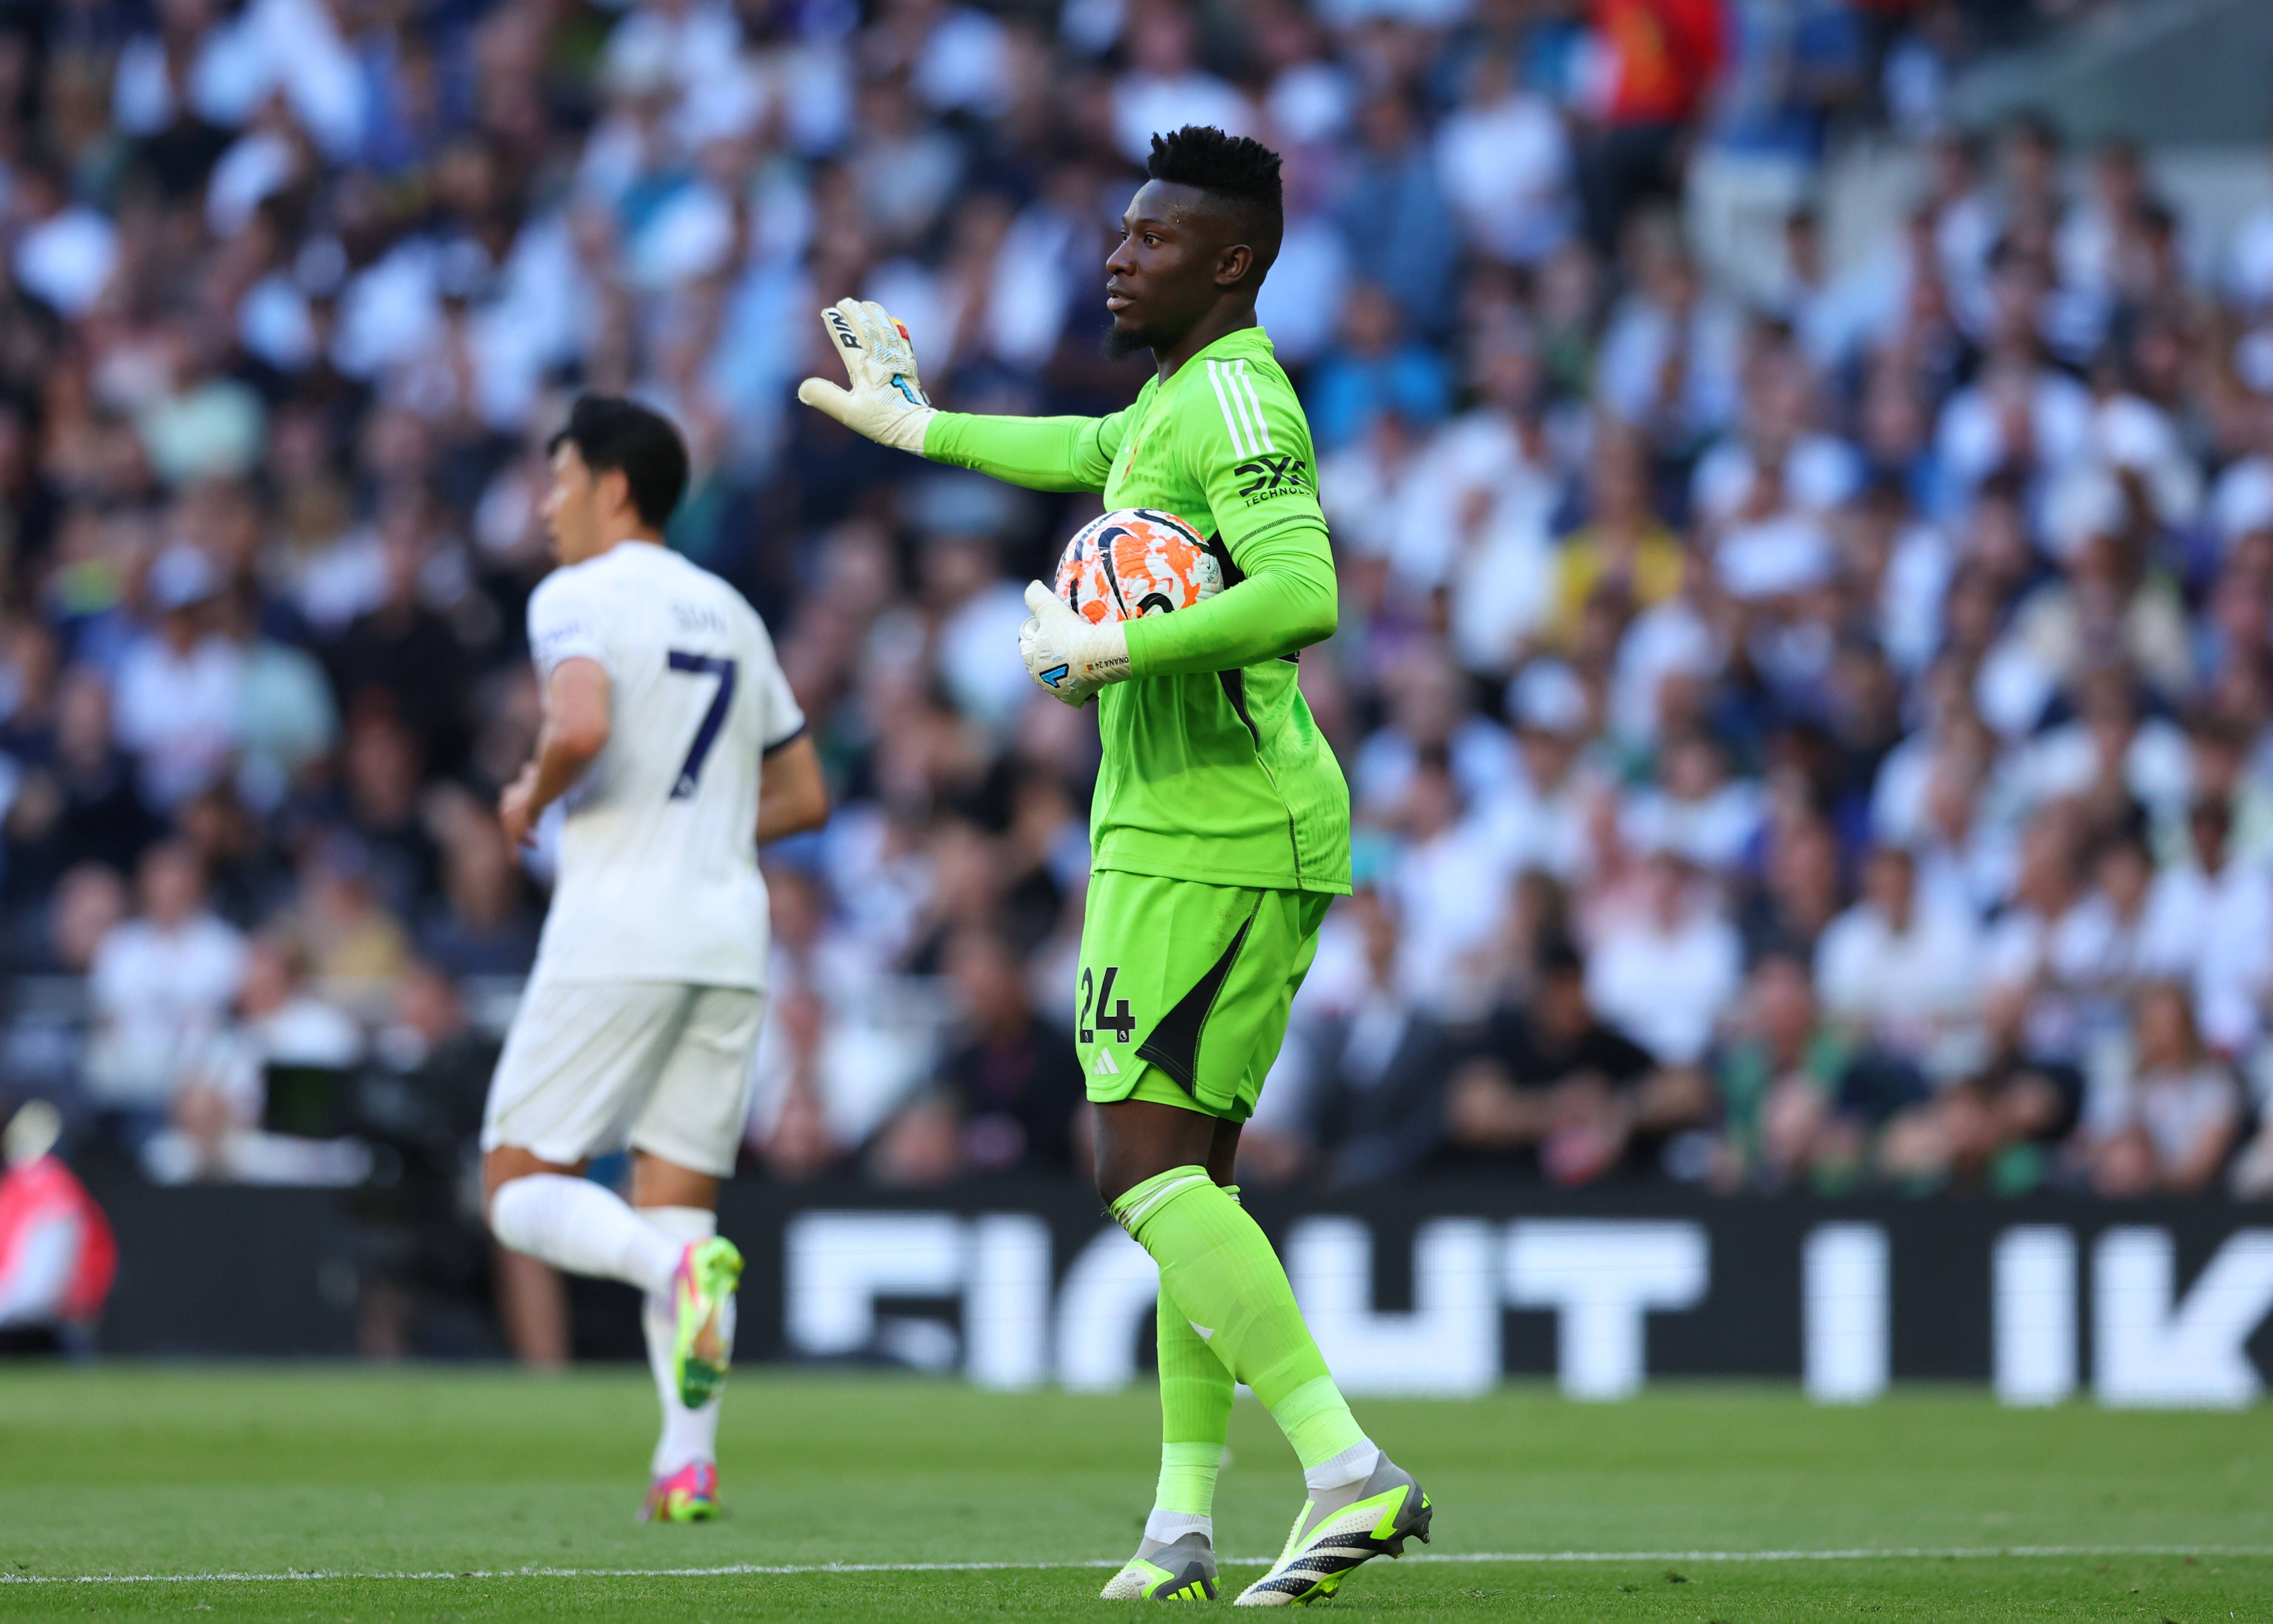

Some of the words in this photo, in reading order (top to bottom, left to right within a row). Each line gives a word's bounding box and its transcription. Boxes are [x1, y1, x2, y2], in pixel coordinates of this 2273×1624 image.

[1095, 662, 1103, 670] 24
[1104, 657, 1129, 667] ONANA
[668, 651, 735, 799] 7
[1080, 962, 1136, 1044] 24
